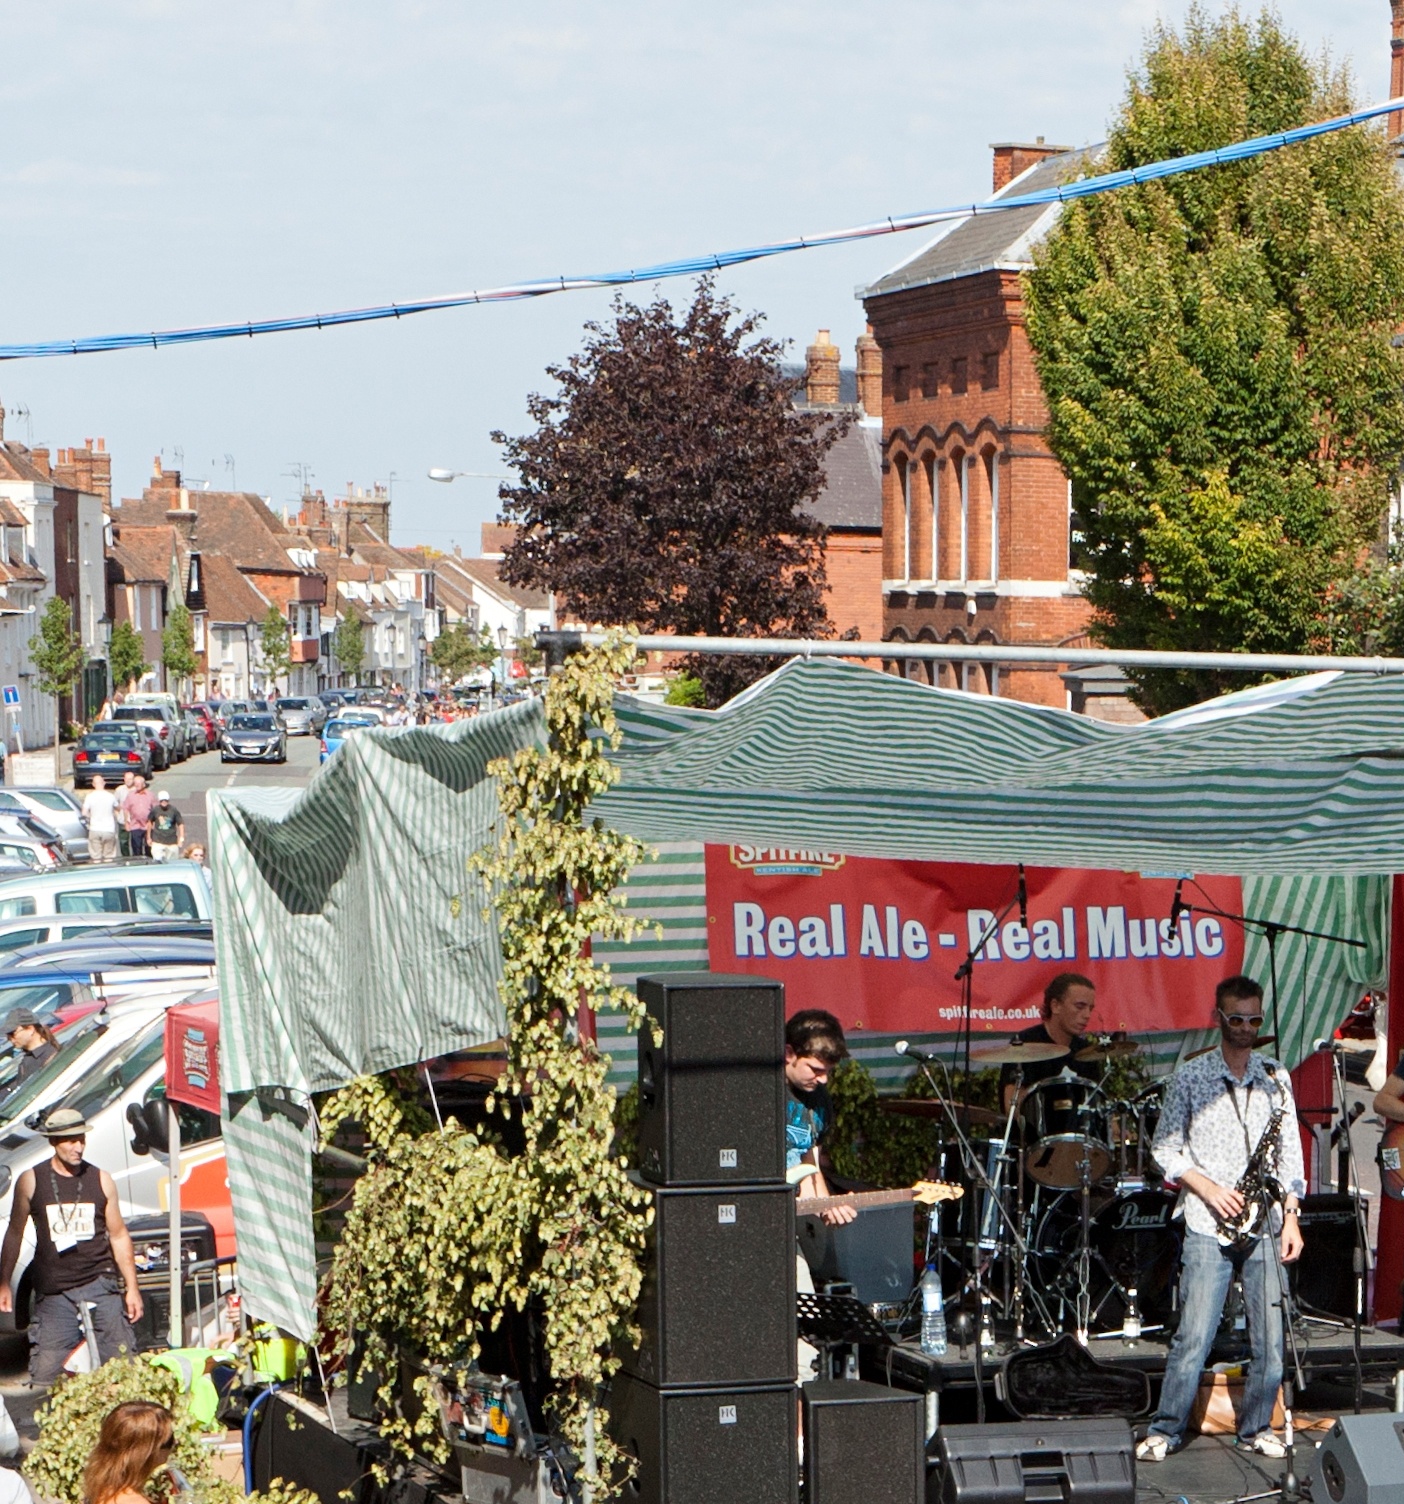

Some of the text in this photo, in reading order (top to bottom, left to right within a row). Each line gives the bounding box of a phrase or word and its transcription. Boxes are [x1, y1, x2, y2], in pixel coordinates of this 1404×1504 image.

[733, 902, 847, 959] Real
[859, 904, 930, 960] Ale
[967, 907, 1077, 961] Real
[1086, 905, 1225, 960] Music
[1111, 1202, 1169, 1230] Pearl
